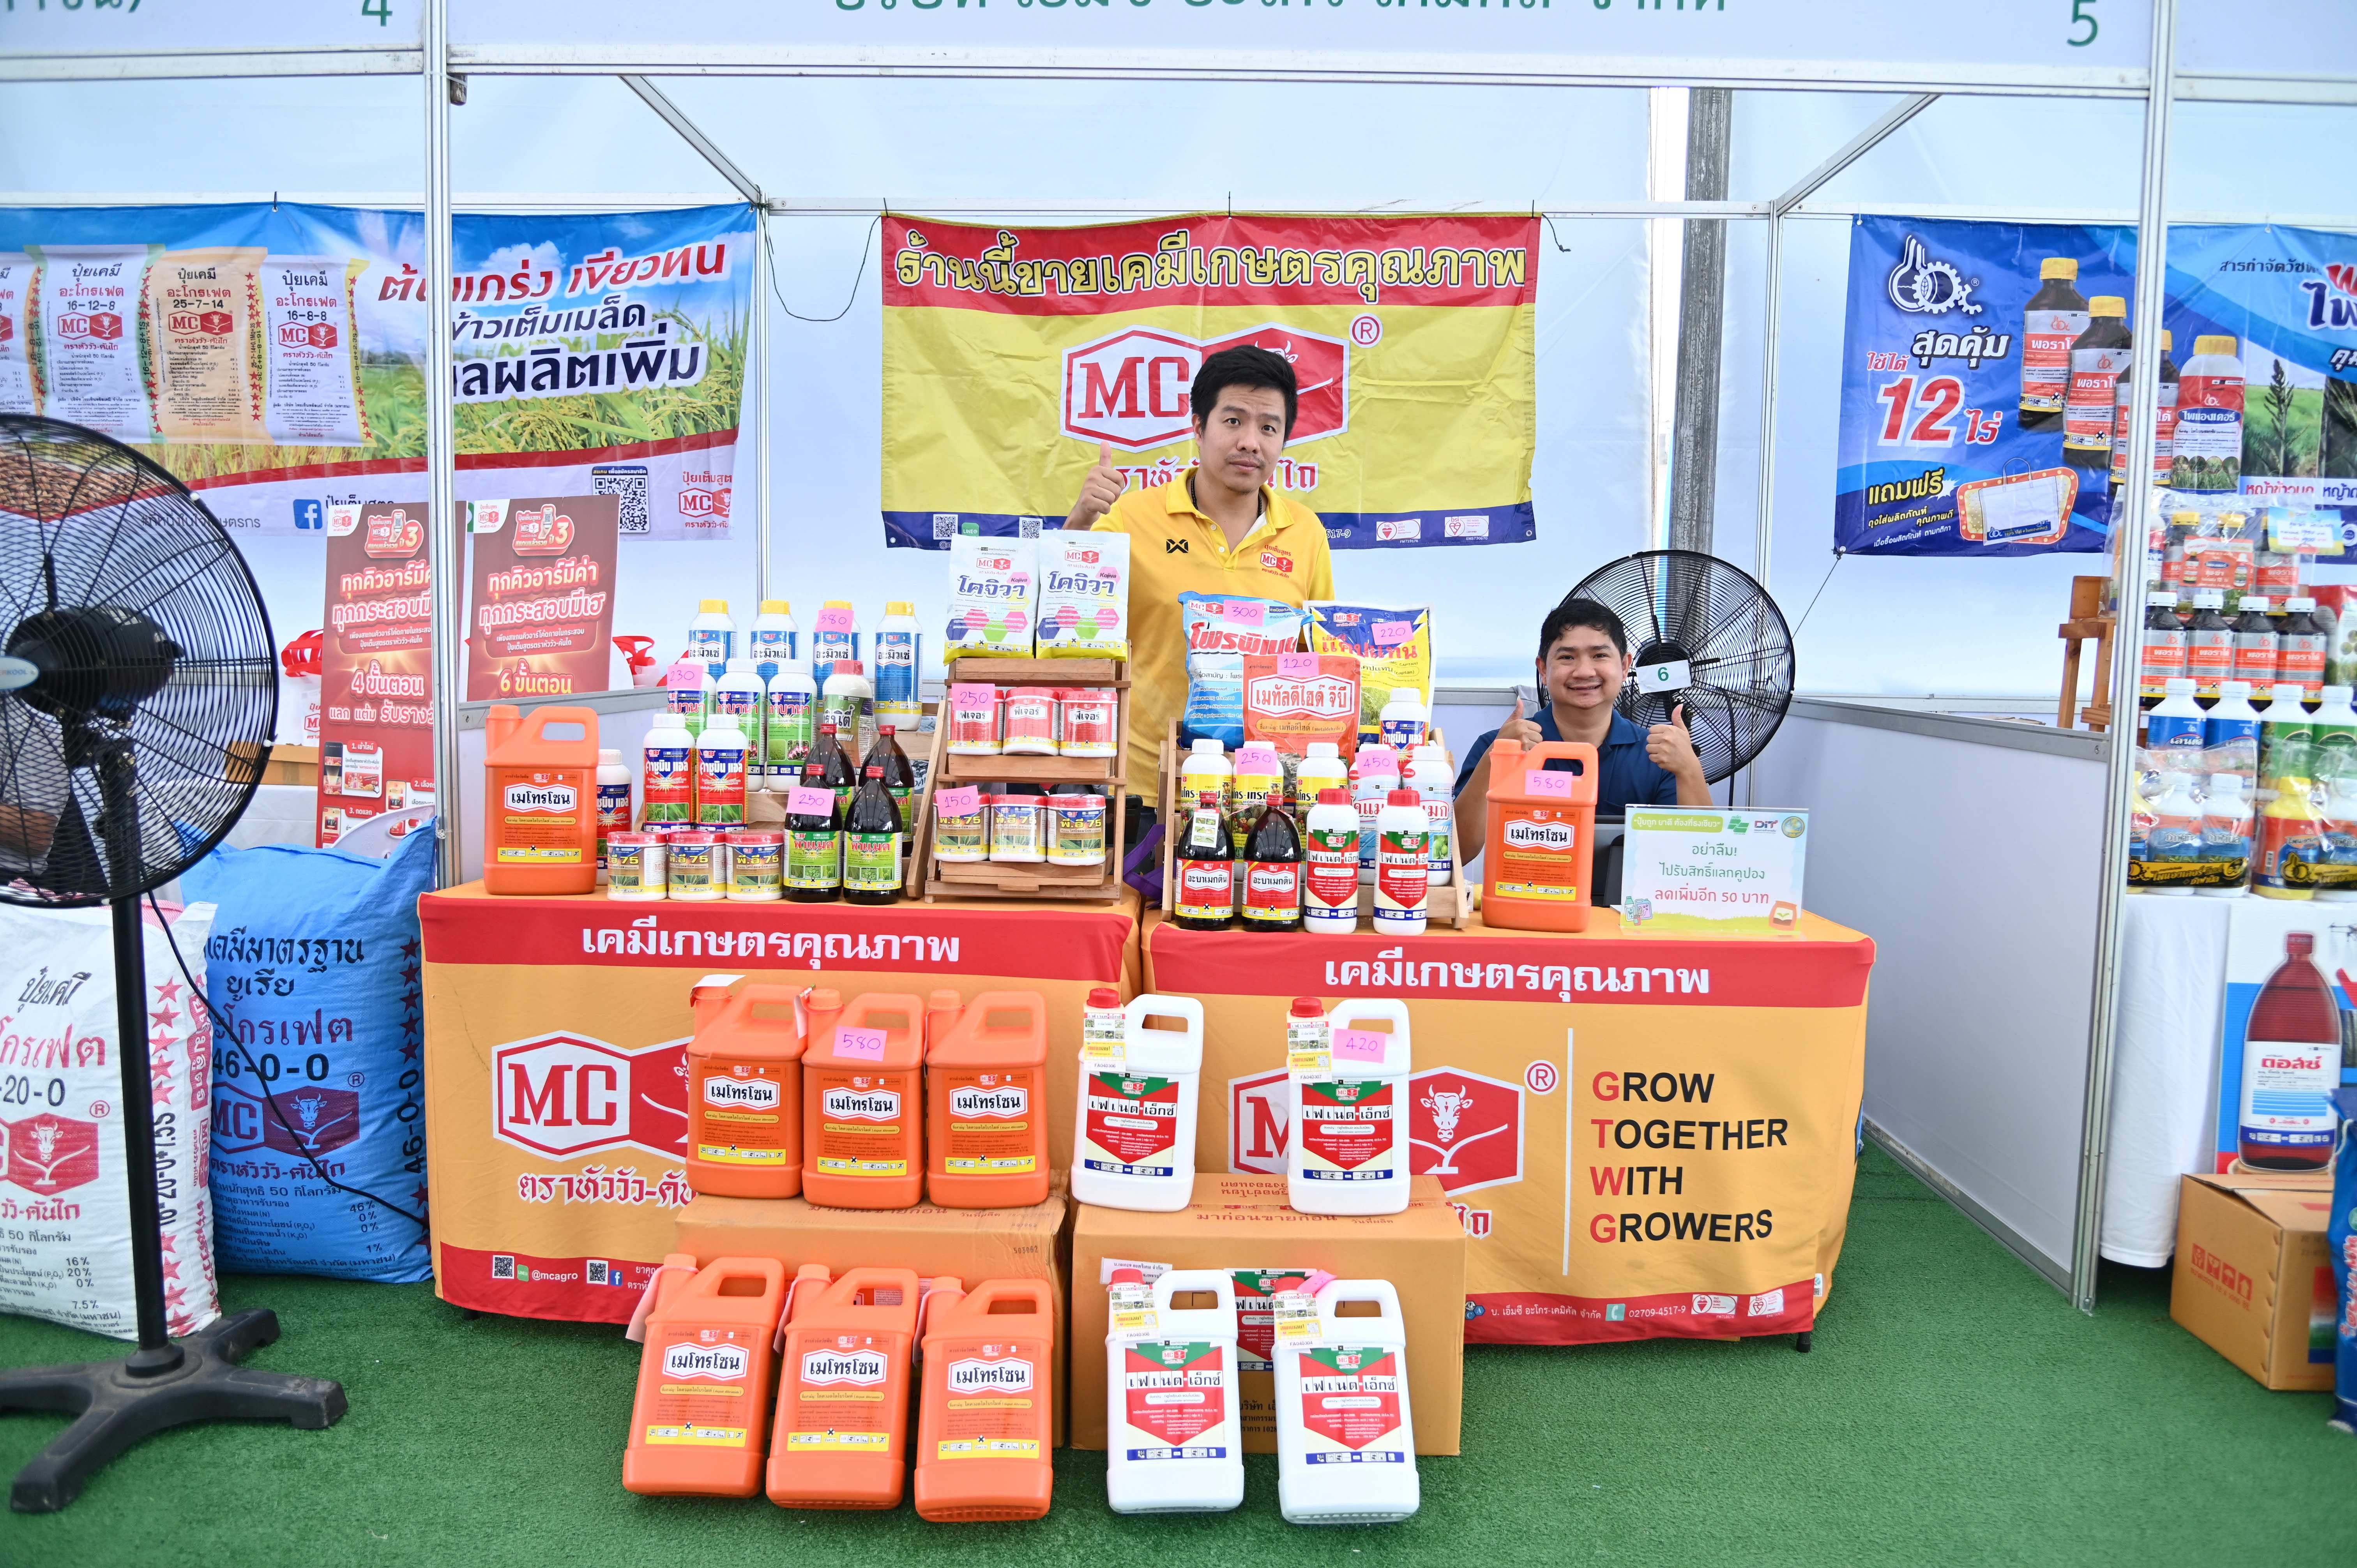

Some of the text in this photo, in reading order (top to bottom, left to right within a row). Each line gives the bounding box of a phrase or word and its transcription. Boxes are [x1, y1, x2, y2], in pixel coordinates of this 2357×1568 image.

[2067, 0, 2098, 47] 5
[72, 263, 122, 282] ปุ๋ยเคมี
[569, 243, 725, 294] เขียวทน
[895, 228, 1527, 305] ร้านนี้ขายเคมีเกษตรคุณภาพ
[178, 267, 216, 284] ปุ๋ยเคมี
[283, 270, 328, 291] ปุ๋ยเคมี
[60, 283, 124, 297] อะโกรเฟต
[167, 285, 231, 297] อะโกรเฟต
[67, 300, 115, 311] 16-12-8
[173, 299, 224, 309] 25-7-14
[276, 293, 336, 307] อะโกรเฟต
[172, 316, 198, 329] MC
[287, 311, 327, 321] 16-8-8
[62, 319, 87, 333] MC
[281, 328, 306, 342] MC
[1912, 325, 2011, 370] สุดคุ้ม
[453, 323, 700, 398] ลผลิตเพิ่ม
[1867, 351, 1908, 371] ใช้ได้
[1078, 355, 1189, 419] MC
[1877, 375, 2002, 448] 12 ไร่
[683, 471, 732, 485] ปุ๋ยเต็มสูต
[1868, 467, 1944, 505] แถมฟรี
[683, 495, 711, 510] MC
[1916, 509, 1954, 526] คุณภาพดี
[406, 527, 419, 547] 3
[555, 522, 569, 544] 3
[1924, 525, 1951, 537] ตามกติกา
[1066, 551, 1081, 560] MC
[1262, 554, 1276, 566] MC
[978, 560, 992, 568] MC
[489, 559, 597, 600] ทุกคิวอาร์มีค่า
[958, 574, 1027, 598] โคจิวา
[1048, 571, 1115, 597] โคจิวา
[479, 588, 606, 635] ทุกกระสอบมีเฮ
[820, 614, 847, 624] 580
[1232, 607, 1257, 618] 300
[1381, 628, 1405, 637] 220
[1322, 641, 1417, 659] แคปแทน
[1284, 659, 1311, 669] 120
[352, 659, 424, 697] 4 ขั้นตอน
[500, 659, 572, 695] 6 ขั้นตอน
[670, 670, 694, 681] 230
[1657, 667, 1670, 682] 6
[960, 691, 988, 707] 250
[1256, 684, 1346, 708] เมทัลดีไฮด์ จีบี
[329, 704, 376, 721] แลก แต้ม
[1279, 722, 1310, 731] เมทัลดีไฮด์
[1242, 752, 1271, 764] 250
[1363, 757, 1390, 768] 450
[1533, 775, 1565, 789] 580
[512, 791, 570, 804] เมโทรโซน
[799, 794, 824, 806] 250
[945, 795, 971, 808] 150
[966, 816, 981, 825] 75
[1088, 819, 1101, 828] 75
[1510, 828, 1568, 844] เมโทรโซน
[1692, 842, 1737, 856] อย่าลืม!
[764, 854, 779, 863] 75
[1188, 874, 1227, 883] อะบาเมกติน
[1659, 861, 1765, 883] ไปรับสิทธิ์แลกคูปอง
[1253, 876, 1292, 885] อะบาเมกติน
[1655, 883, 1769, 904] ลดเพิ่มอีก 50 บาท
[582, 915, 959, 970] เคมีเกษตรคุณภาพ
[1325, 946, 1710, 1002] เคมีเกษตรคุณภาพ
[227, 968, 295, 1001] ยูเรีย
[842, 1033, 881, 1050] 580
[1346, 1037, 1378, 1051] 420
[213, 1048, 329, 1081] 46-0-0
[712, 1084, 772, 1100] เมโทรโซน
[1592, 1071, 1715, 1104] GROW
[508, 1064, 617, 1127] MC
[957, 1093, 1021, 1111] เมโทรโซน
[830, 1094, 893, 1114] เมโทรโซน
[1091, 1099, 1176, 1116] เฟเนต-เอ็กซ์
[1306, 1105, 1391, 1119] เฟเนต-เอ็กซ์
[212, 1102, 257, 1153] MC
[397, 1068, 426, 1174] 46-0-0
[1591, 1118, 1788, 1151] TOGETHER
[1589, 1165, 1683, 1196] WITH
[270, 1187, 288, 1197] 50
[295, 1183, 341, 1197] กิโลกรัม
[350, 1201, 375, 1213] 46%
[359, 1211, 377, 1222] 0%
[361, 1222, 379, 1233] 0%
[1589, 1208, 1773, 1243] GROWERS
[9, 1229, 71, 1243] 50 กิโลกรัม
[366, 1243, 383, 1253] 1%
[65, 1257, 90, 1266] 16%
[67, 1267, 92, 1277] 20%
[532, 1269, 578, 1283] @mcagro
[76, 1278, 94, 1287] 0%
[72, 1300, 99, 1310] 7.5%
[1525, 1304, 1577, 1317] อะโกร-เคมิคัล
[1580, 1310, 1601, 1319] จำกัด
[1629, 1305, 1686, 1318] 02709-4517-9
[671, 1351, 740, 1371] เมโทรโซน
[809, 1358, 879, 1377] เมโทรโซน
[956, 1365, 1026, 1385] เมโทรโซน
[1130, 1372, 1221, 1387] เฟเนต-เอ็กซ์
[1305, 1377, 1395, 1392] เฟเนต-เอ็กซ์
